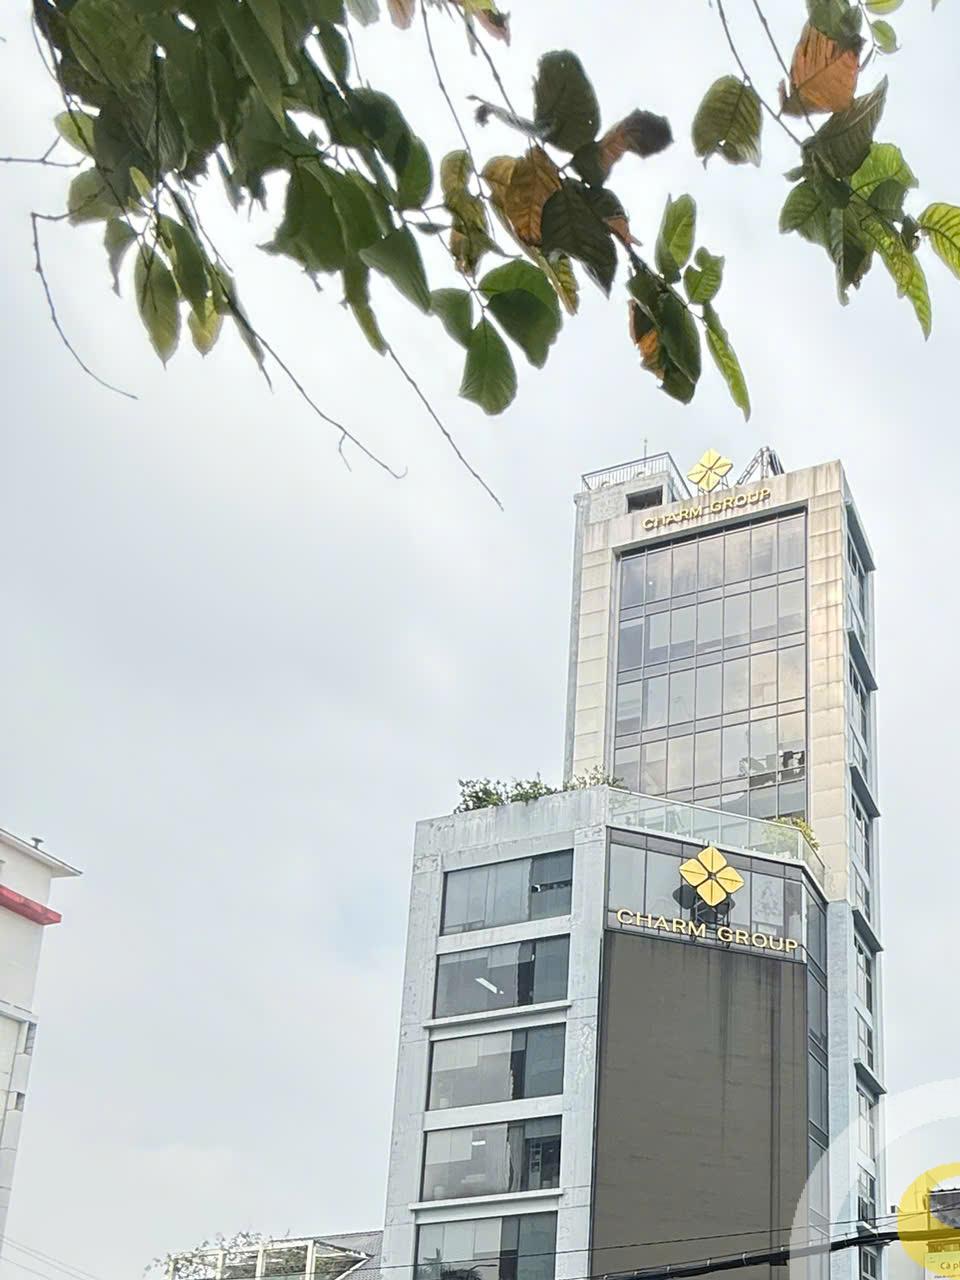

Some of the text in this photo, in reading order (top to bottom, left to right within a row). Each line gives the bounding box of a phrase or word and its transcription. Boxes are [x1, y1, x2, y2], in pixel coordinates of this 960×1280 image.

[642, 487, 771, 531] CHARM GROUP
[616, 908, 798, 953] CHARM GROUP
